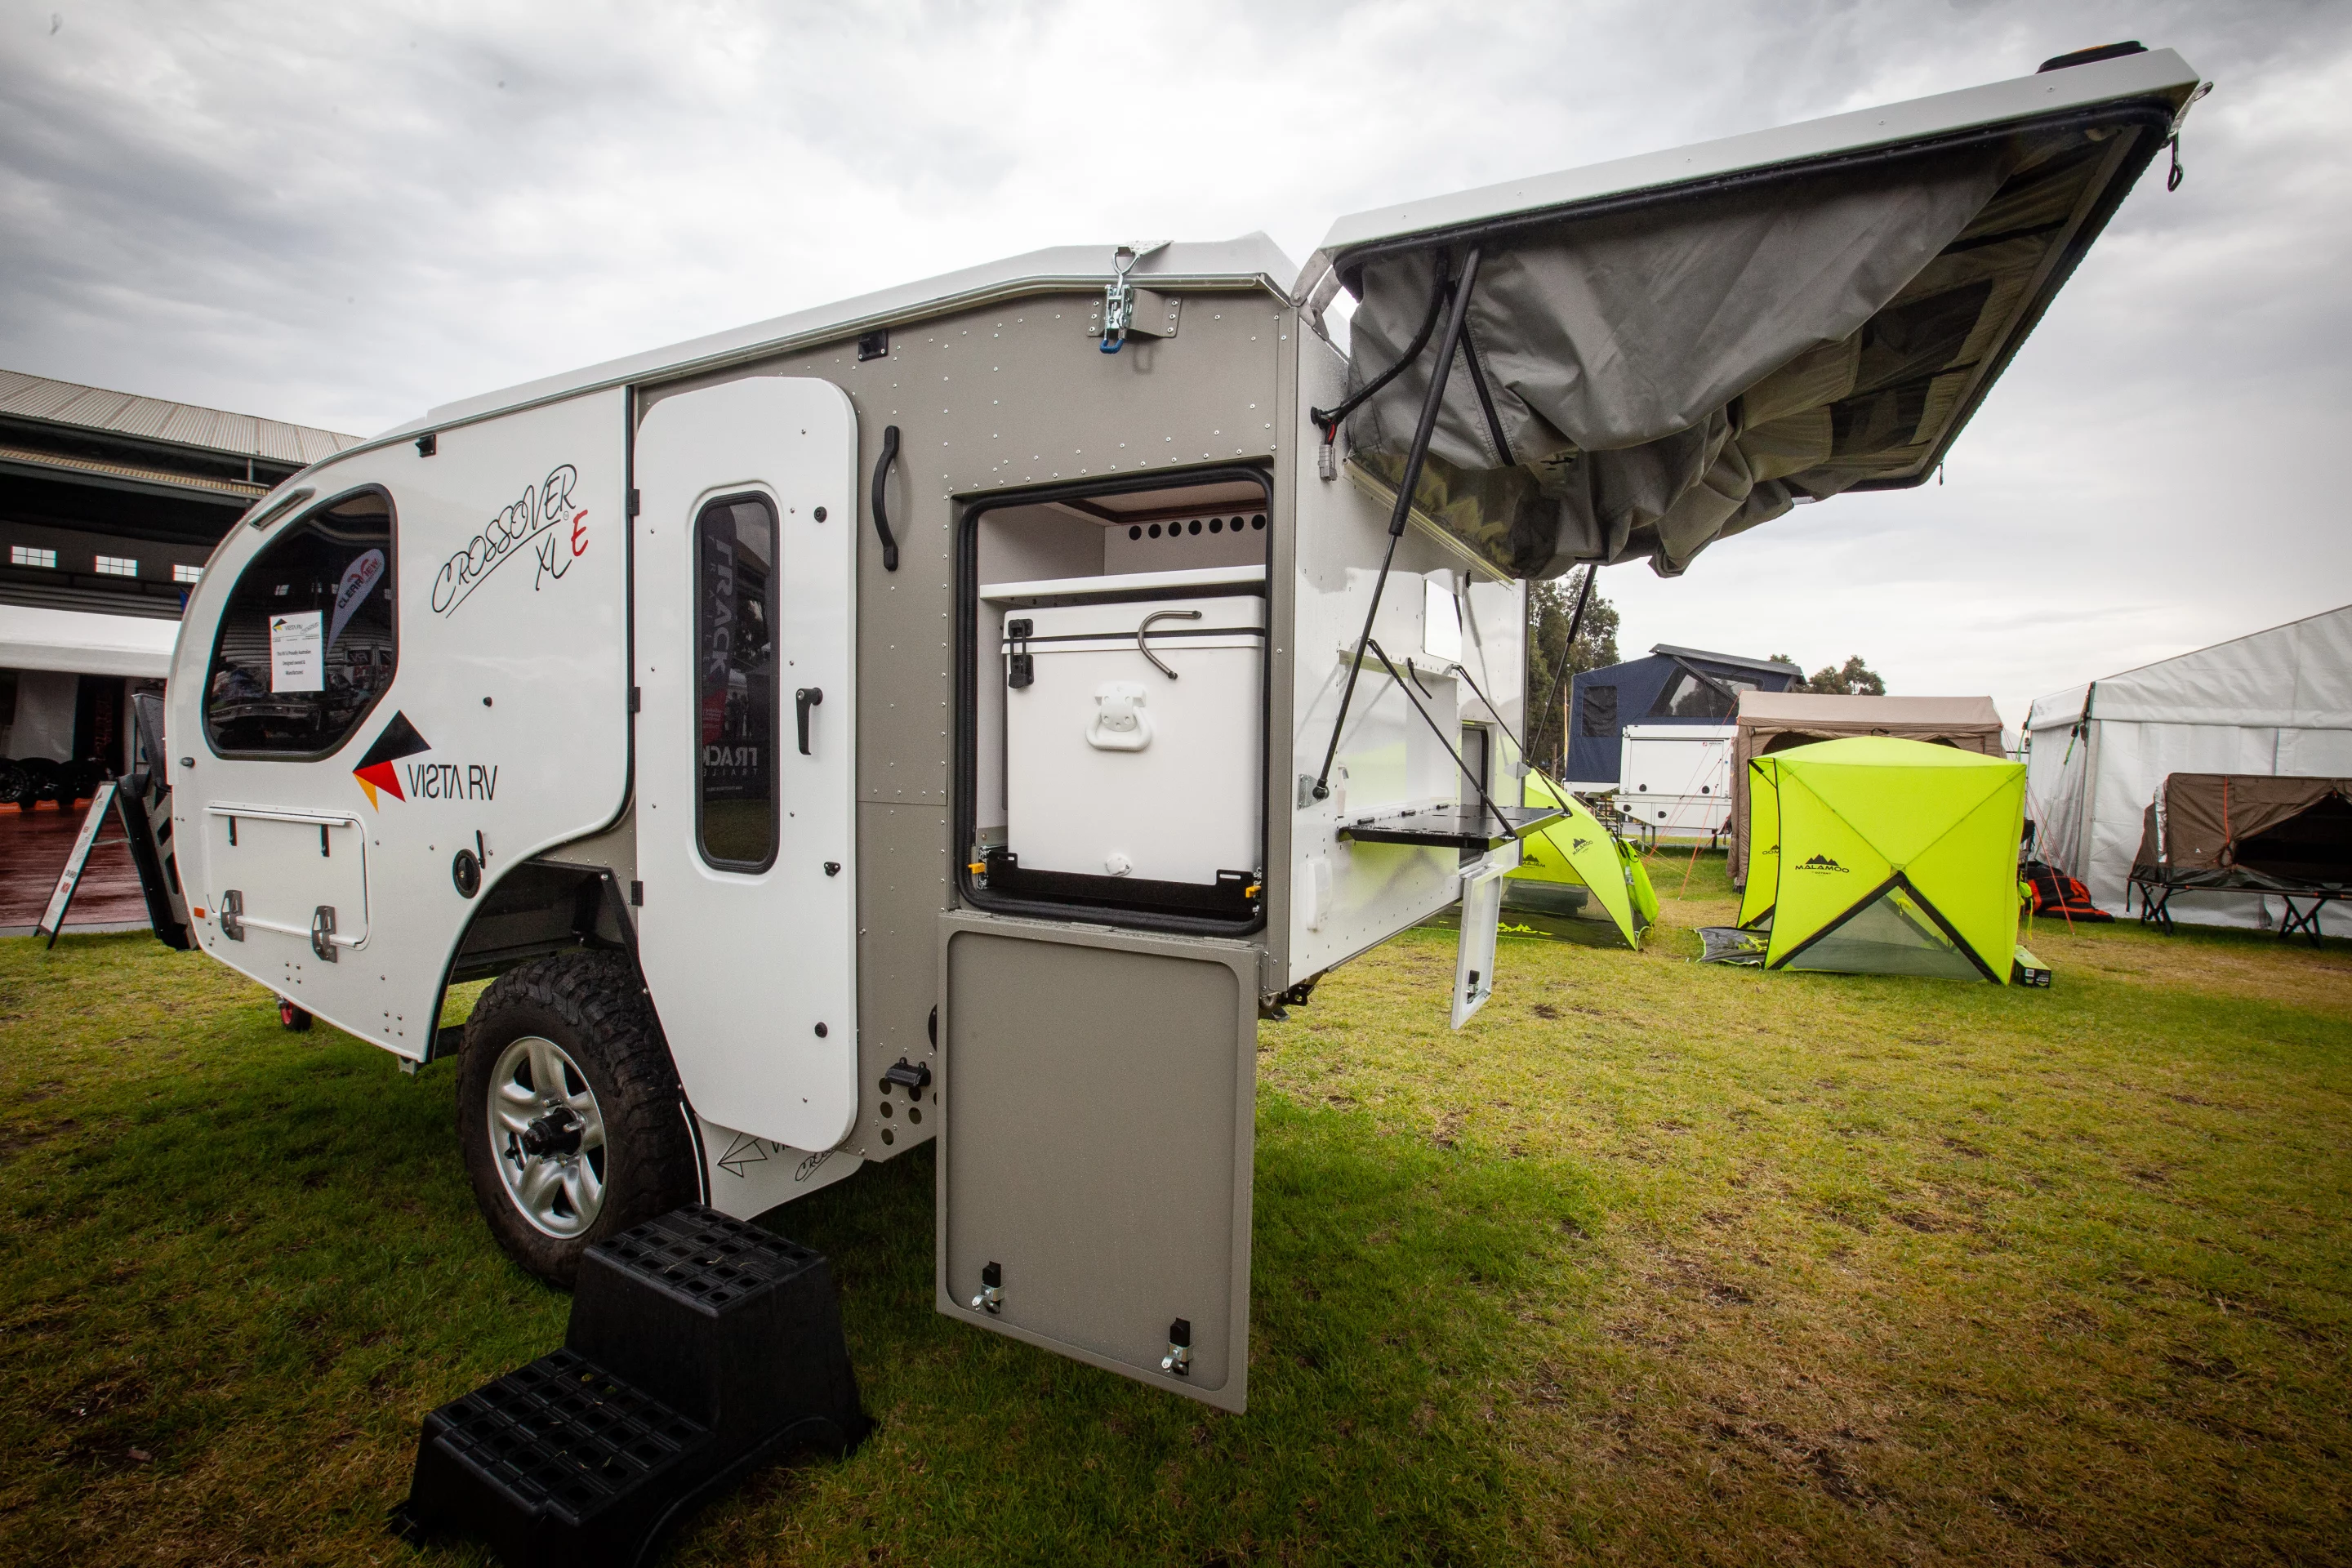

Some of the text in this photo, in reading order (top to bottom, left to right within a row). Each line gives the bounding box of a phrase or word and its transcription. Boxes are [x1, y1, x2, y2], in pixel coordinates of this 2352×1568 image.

[432, 464, 577, 613] CROSSOVER
[407, 763, 498, 801] VISTA RV
[1572, 840, 1593, 857] MALAMOO
[1794, 864, 1850, 873] MALAMOO
